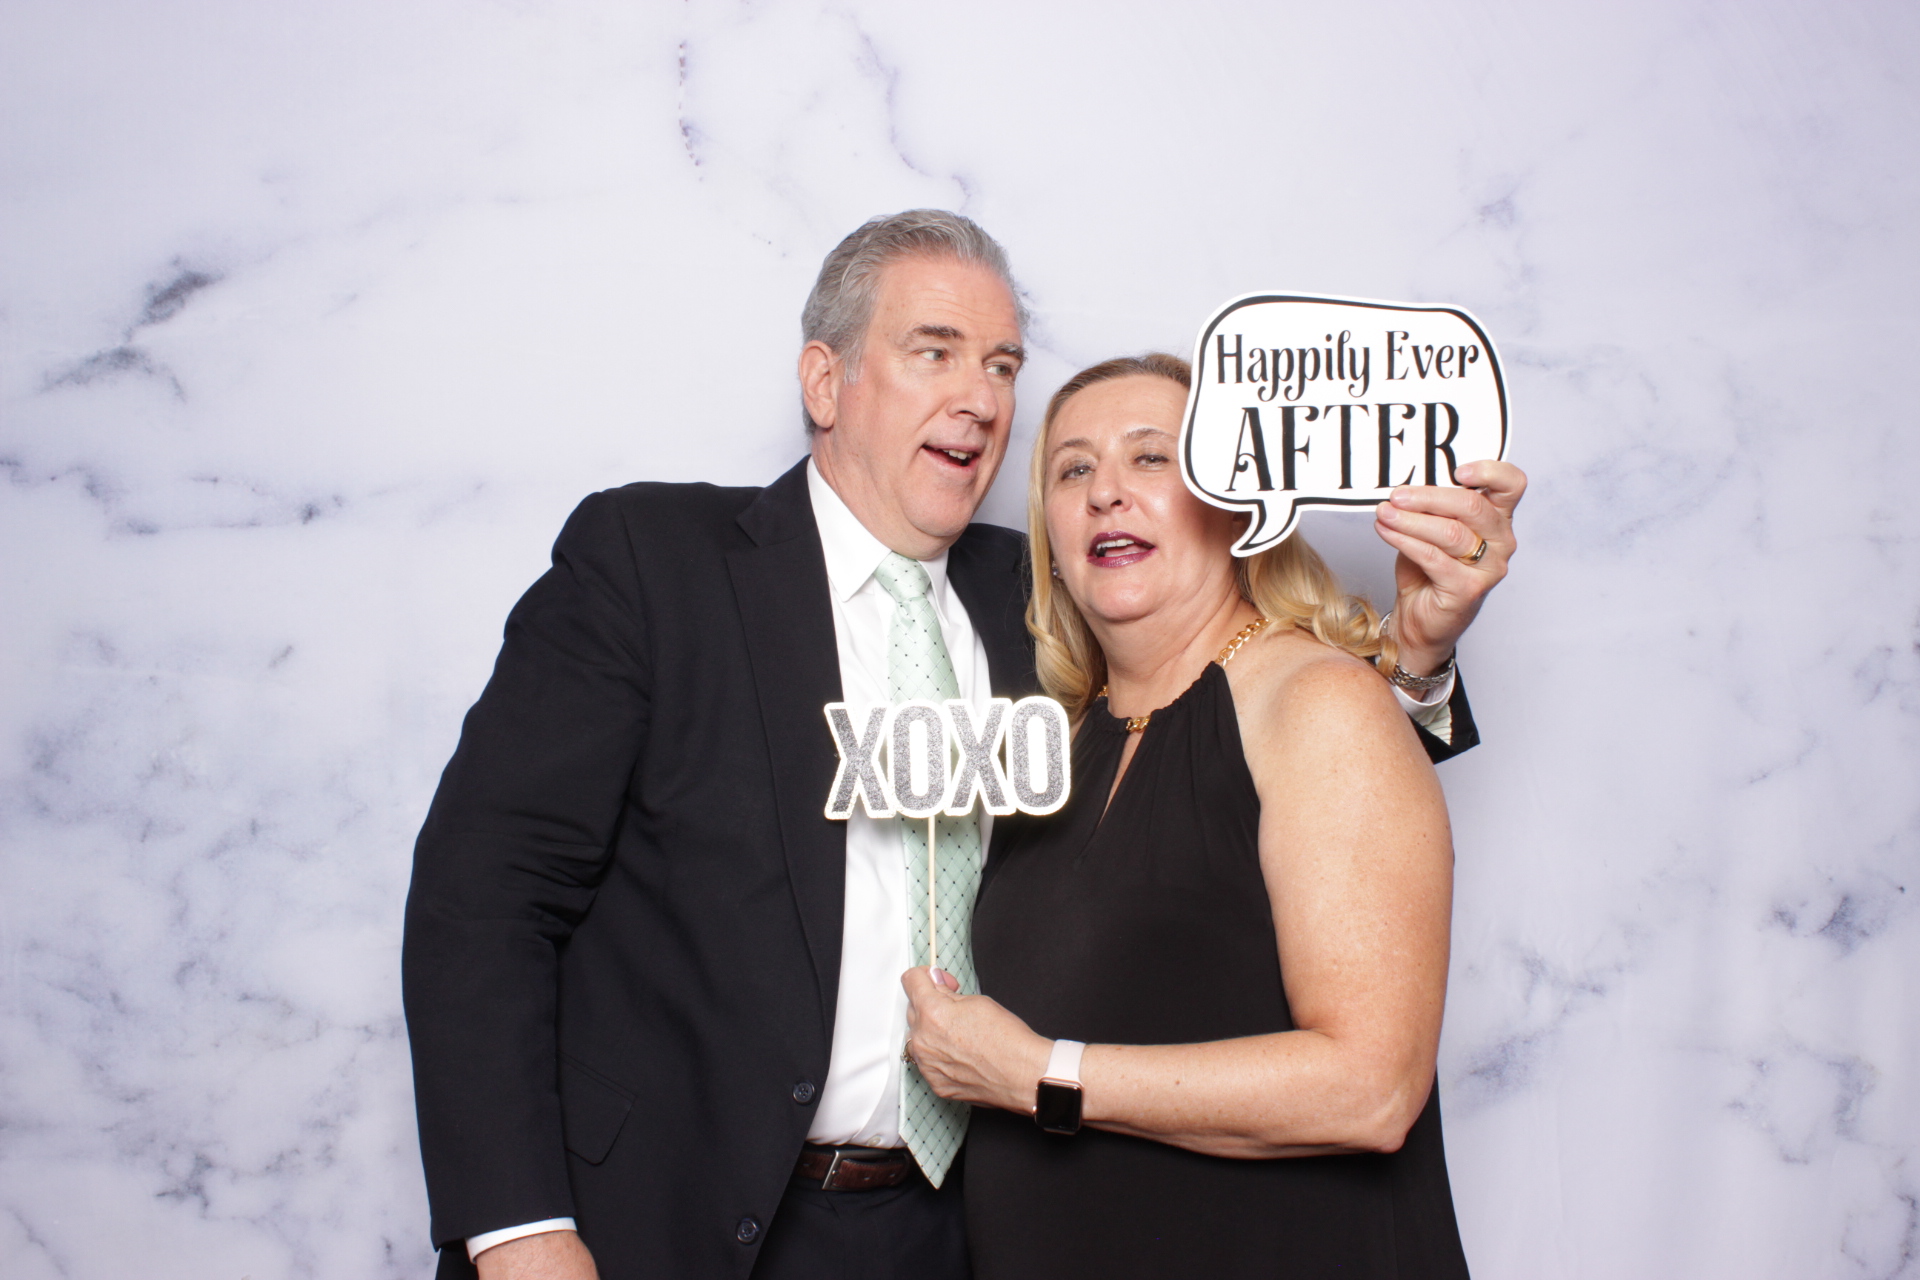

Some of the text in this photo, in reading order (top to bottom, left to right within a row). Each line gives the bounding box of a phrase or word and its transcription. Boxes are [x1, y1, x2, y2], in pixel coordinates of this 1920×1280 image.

[1215, 329, 1480, 402] Happily Ever
[1224, 402, 1467, 492] AFTER
[828, 701, 1064, 813] XOXO
